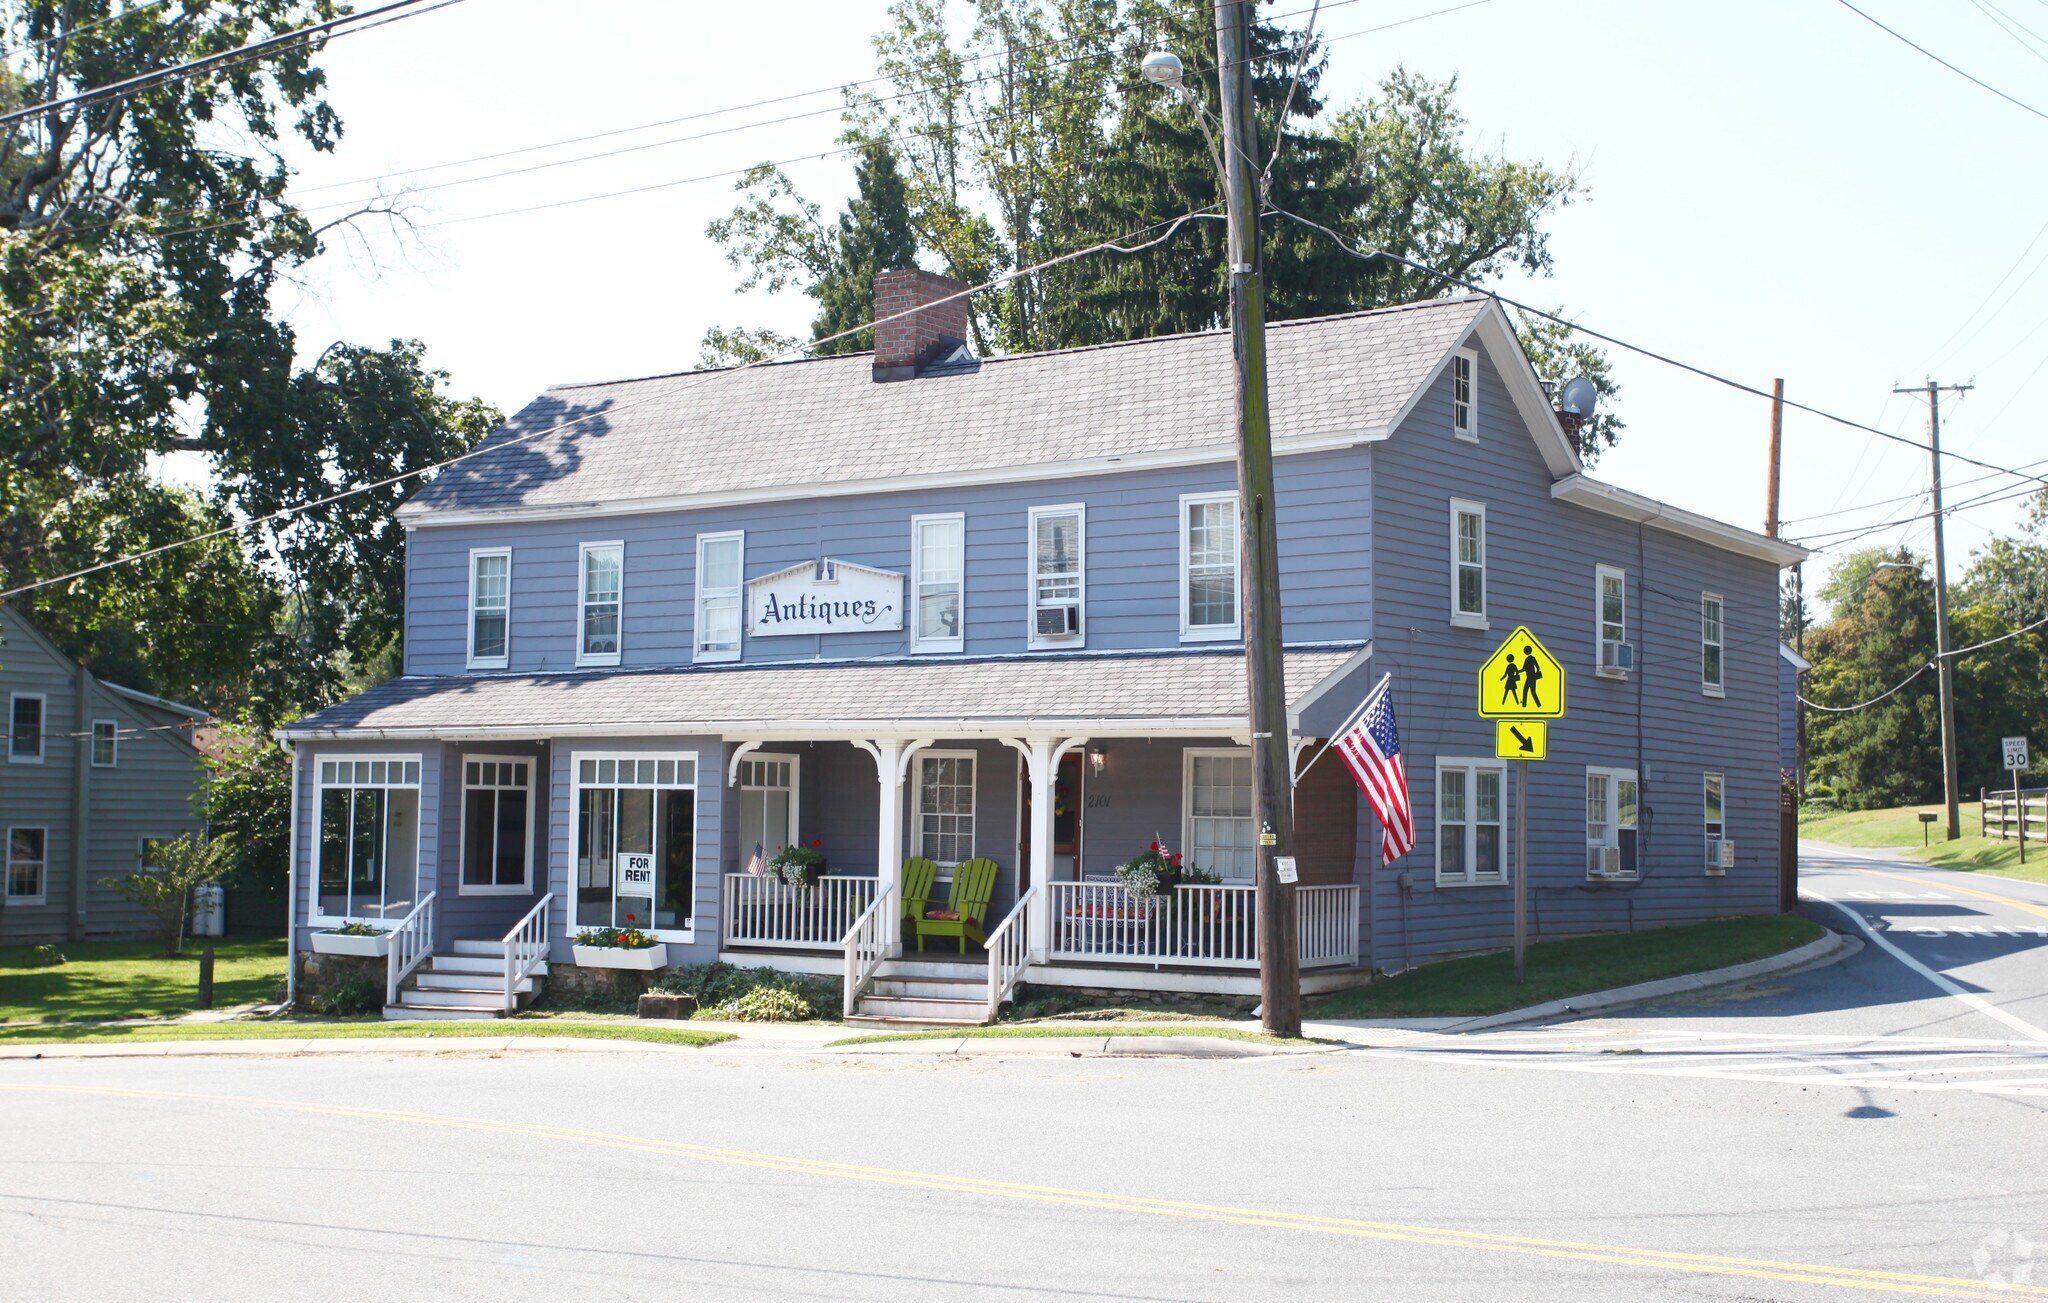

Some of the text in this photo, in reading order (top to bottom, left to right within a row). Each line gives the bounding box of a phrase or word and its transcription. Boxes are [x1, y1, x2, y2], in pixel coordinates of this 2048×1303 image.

[760, 592, 892, 625] Antiques
[2007, 753, 2026, 766] 30
[629, 857, 649, 869] FOR
[625, 870, 651, 882] RENT
